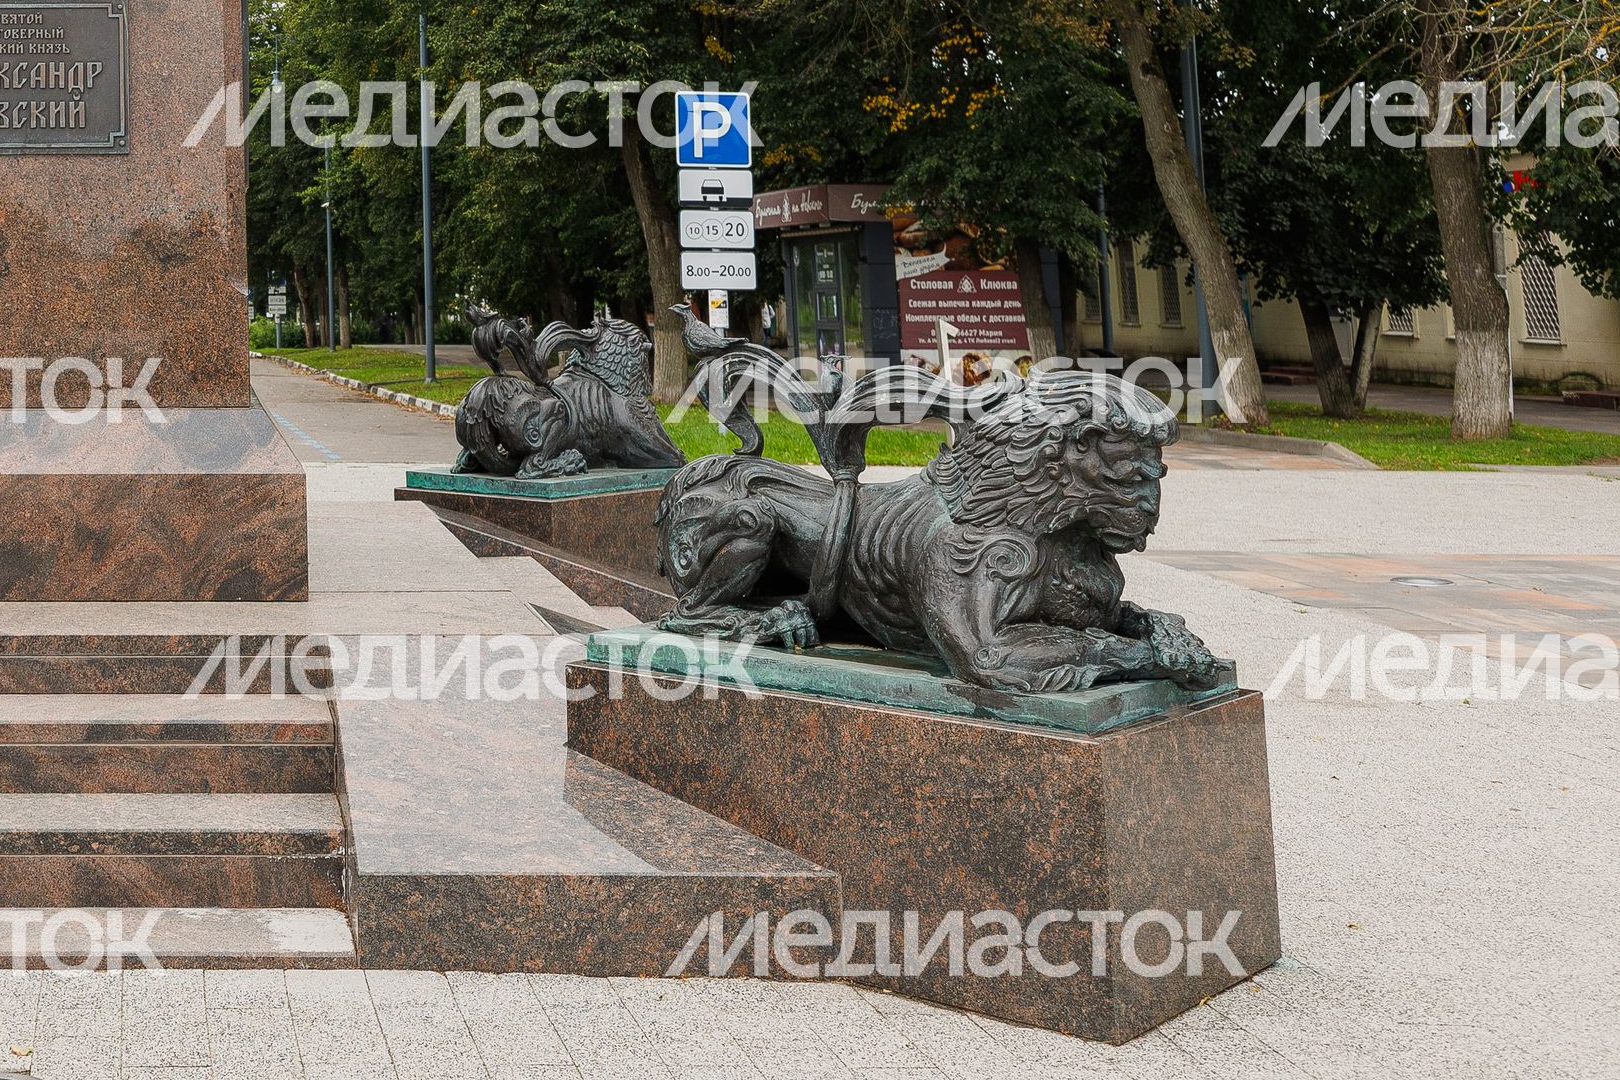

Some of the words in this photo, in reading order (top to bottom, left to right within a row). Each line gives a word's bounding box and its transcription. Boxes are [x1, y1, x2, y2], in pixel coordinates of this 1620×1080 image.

[28, 42, 71, 54] КНЯЗЬ
[689, 226, 700, 235] 10
[705, 225, 719, 236] 15
[725, 222, 745, 237] 20
[910, 279, 954, 289] Столовая
[980, 279, 1018, 289] Клюква
[908, 299, 937, 308] Свежая
[938, 300, 970, 308] выпечка
[971, 299, 1002, 309] каждый
[1003, 300, 1022, 309] день
[956, 313, 981, 324] обеды
